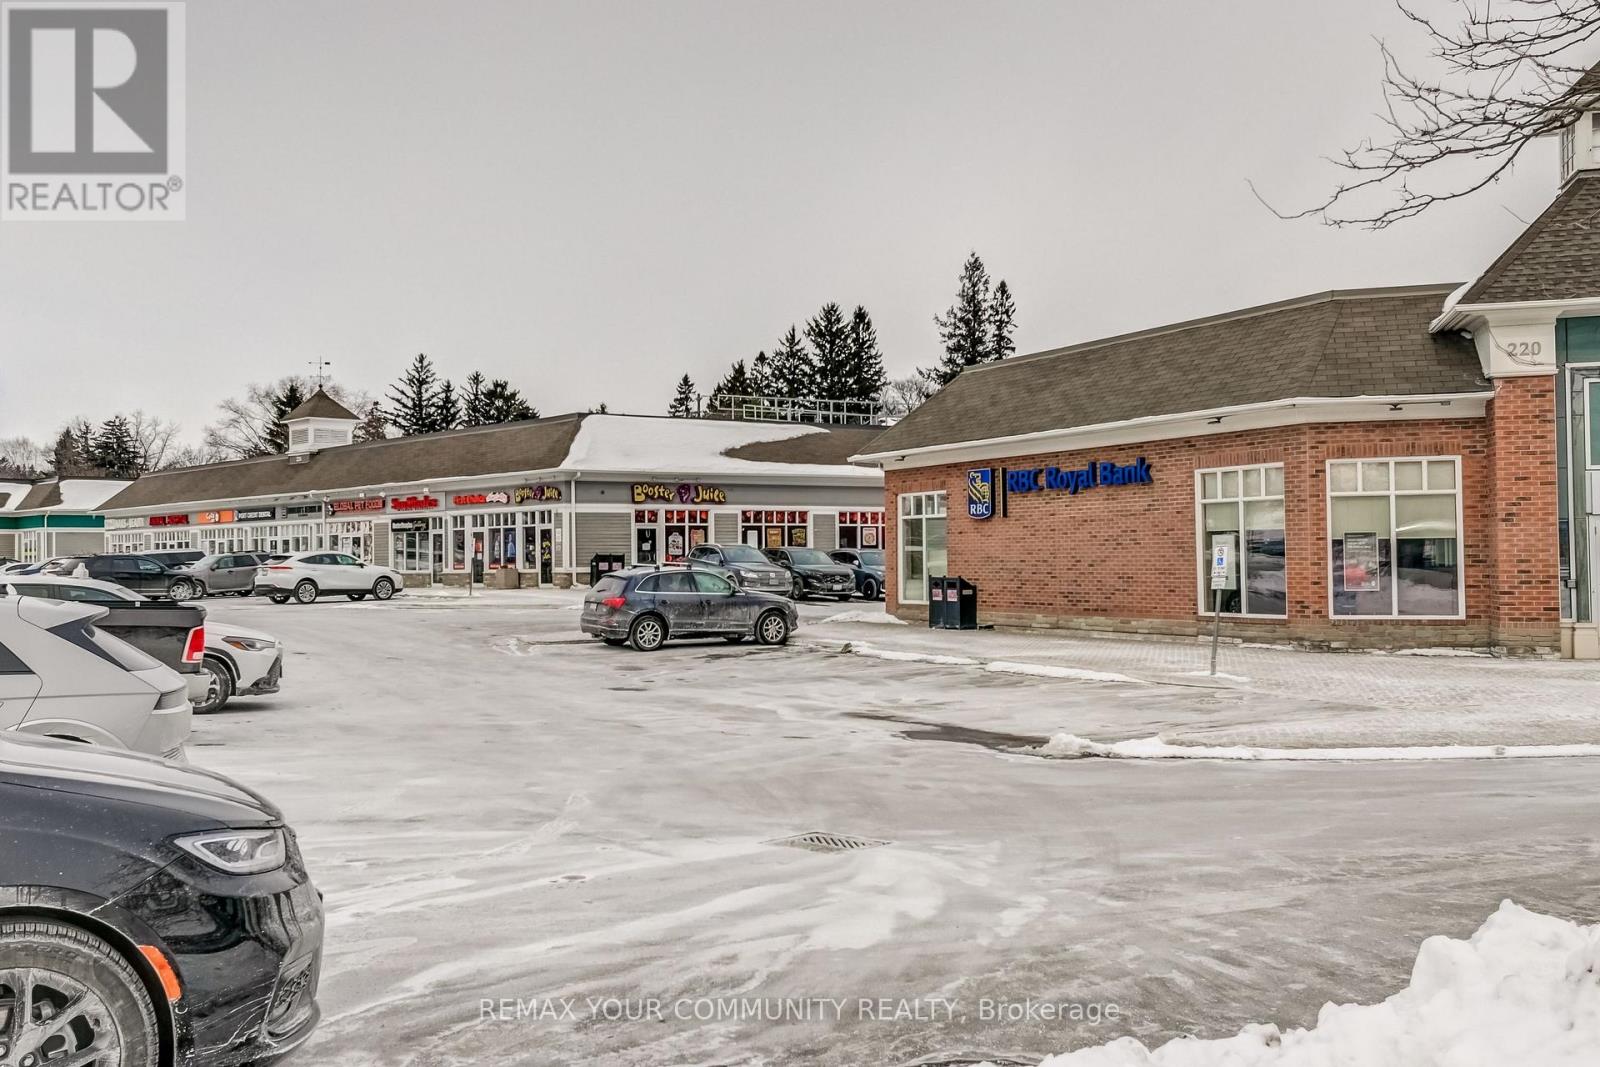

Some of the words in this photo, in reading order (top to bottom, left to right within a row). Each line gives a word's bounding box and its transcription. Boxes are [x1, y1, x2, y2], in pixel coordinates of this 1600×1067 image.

[1507, 341, 1541, 357] 220
[1007, 469, 1043, 493] RBC
[1045, 461, 1098, 495] Royal
[1099, 457, 1153, 486] Bank
[632, 484, 675, 502] Booster
[693, 485, 726, 502] Juice
[970, 503, 989, 515] RBC
